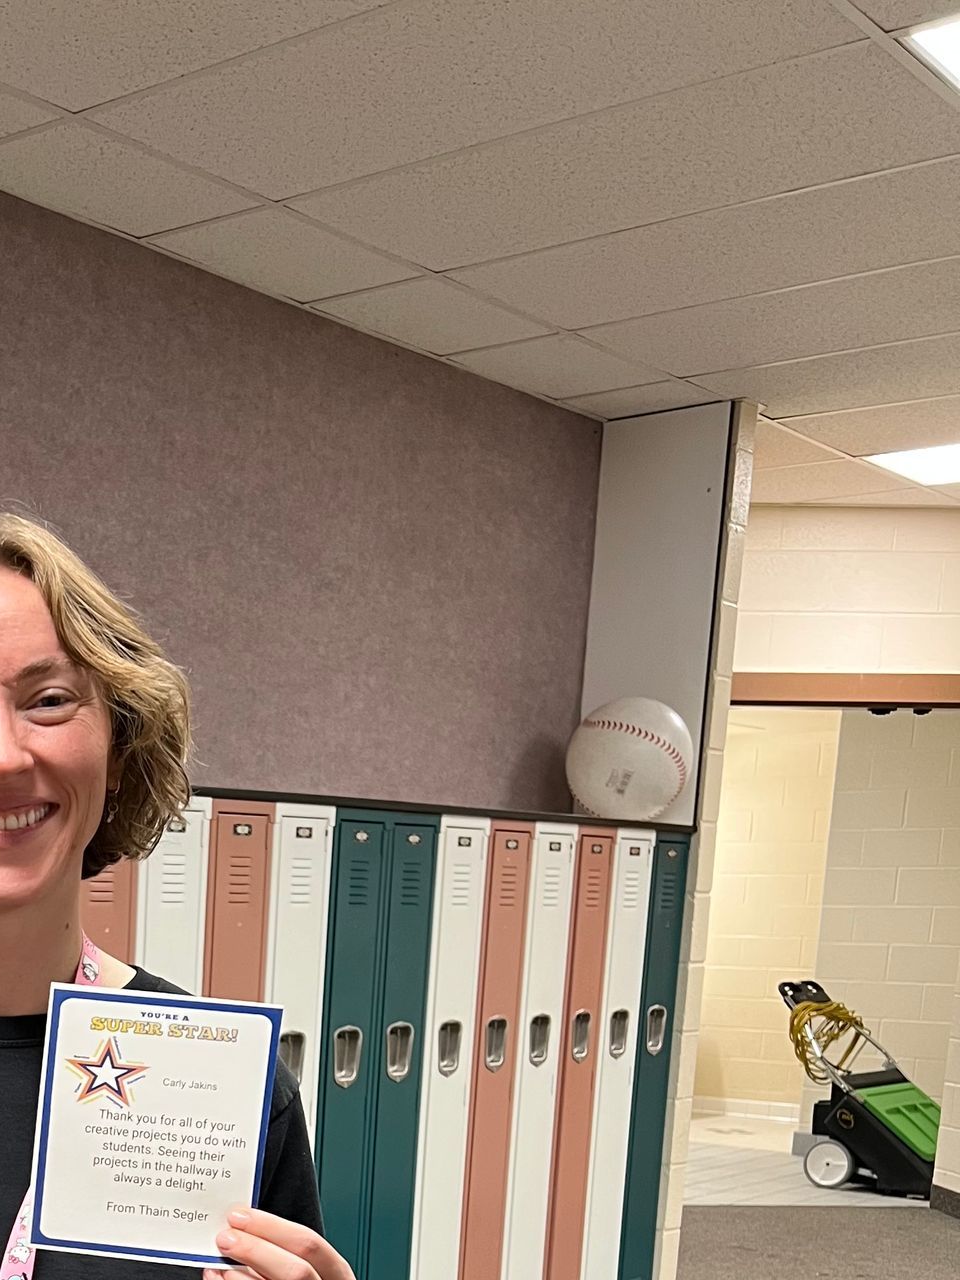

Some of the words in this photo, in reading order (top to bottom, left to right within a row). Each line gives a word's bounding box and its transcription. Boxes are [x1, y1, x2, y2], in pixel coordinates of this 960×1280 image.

[140, 1011, 179, 1021] YOU'RE
[90, 1016, 163, 1036] SUPER
[167, 1023, 239, 1043] STAR!
[162, 1077, 187, 1090] Carly
[188, 1079, 218, 1091] Jakins
[99, 1108, 134, 1122] Thank
[136, 1114, 157, 1125] you
[160, 1114, 177, 1126] for
[179, 1117, 193, 1128] all
[195, 1119, 208, 1129] of
[210, 1122, 236, 1133] your
[84, 1124, 129, 1137] creative
[131, 1129, 178, 1142] projects
[180, 1134, 201, 1145] you
[204, 1135, 219, 1146] do
[222, 1136, 247, 1149] with
[102, 1141, 154, 1155] students.
[157, 1145, 196, 1161] Seeing
[199, 1150, 226, 1162] their
[92, 1155, 139, 1169] projects
[141, 1159, 152, 1170] in
[154, 1161, 173, 1172] the
[175, 1162, 219, 1179] hallway
[221, 1168, 232, 1179] is
[113, 1172, 152, 1187] always
[155, 1178, 162, 1186] a
[165, 1178, 207, 1192] delight.
[106, 1201, 136, 1215] From
[139, 1204, 170, 1218] Thain
[172, 1208, 209, 1222] Segler
